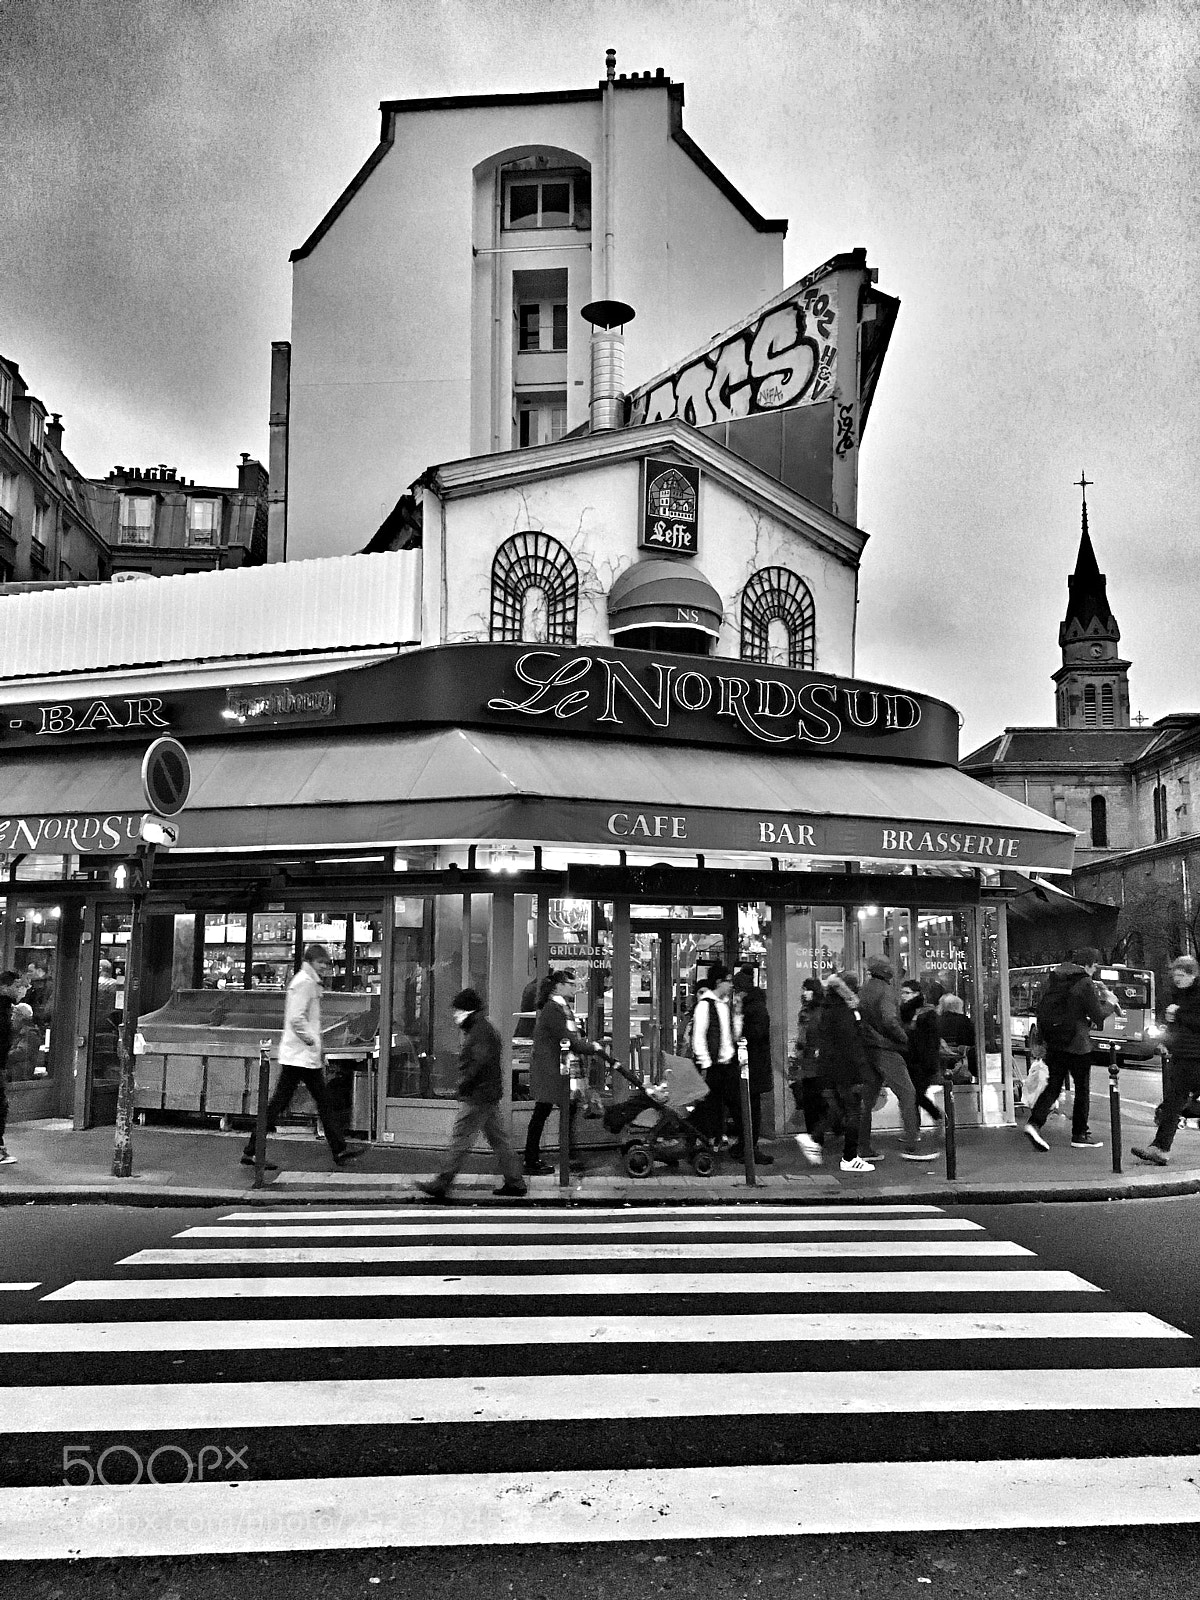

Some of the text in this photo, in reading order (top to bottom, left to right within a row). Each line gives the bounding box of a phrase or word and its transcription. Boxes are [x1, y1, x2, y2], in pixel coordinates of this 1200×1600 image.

[650, 520, 692, 548] Leffe
[677, 608, 699, 622] NS
[488, 651, 592, 719] Le
[36, 698, 170, 735] BAR
[607, 812, 1020, 859] CAFE BAR BRASSERIE
[795, 960, 833, 969] MAISON
[925, 961, 967, 971] CHOCOLAT
